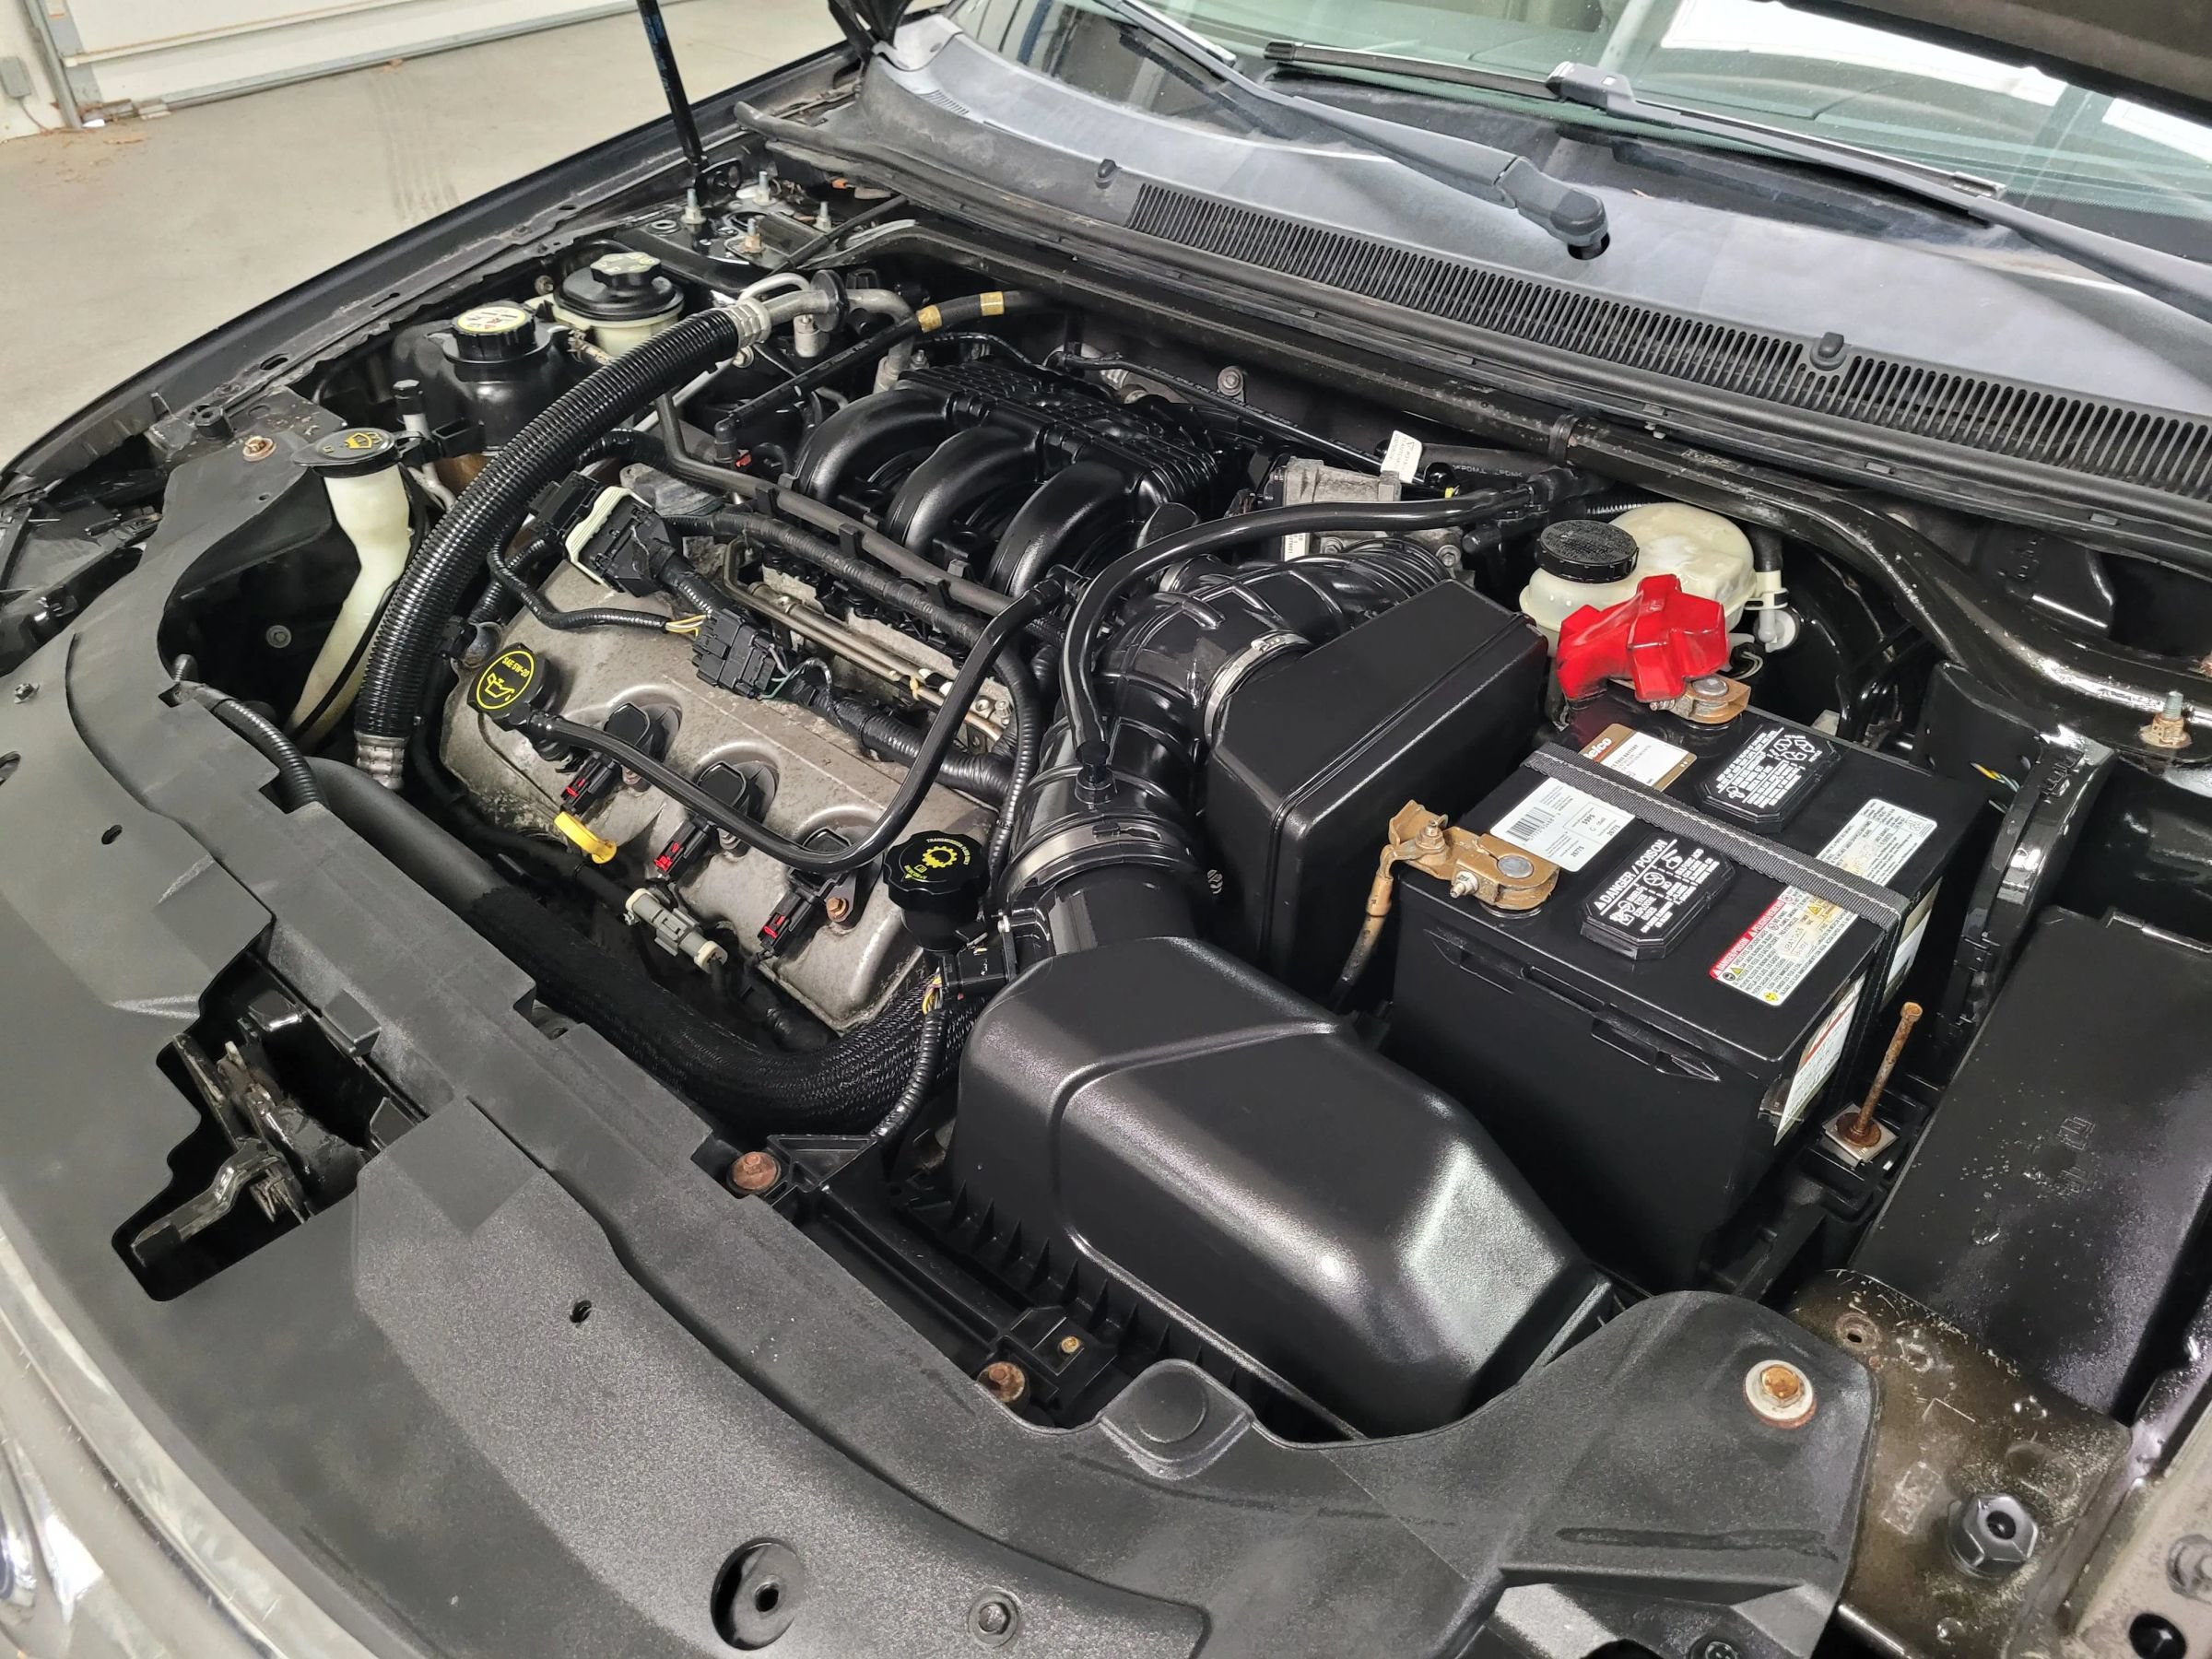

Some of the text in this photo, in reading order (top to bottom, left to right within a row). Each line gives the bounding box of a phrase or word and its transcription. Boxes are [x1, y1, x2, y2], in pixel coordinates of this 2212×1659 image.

[502, 657, 530, 677] SAE 5W-20
[926, 838, 963, 848] TRANSMISSION
[1600, 871, 1637, 903] DANGER
[1638, 839, 1669, 867] POISON
[1661, 880, 1672, 889] NO
[1632, 895, 1656, 917] EXPLOSIVE
